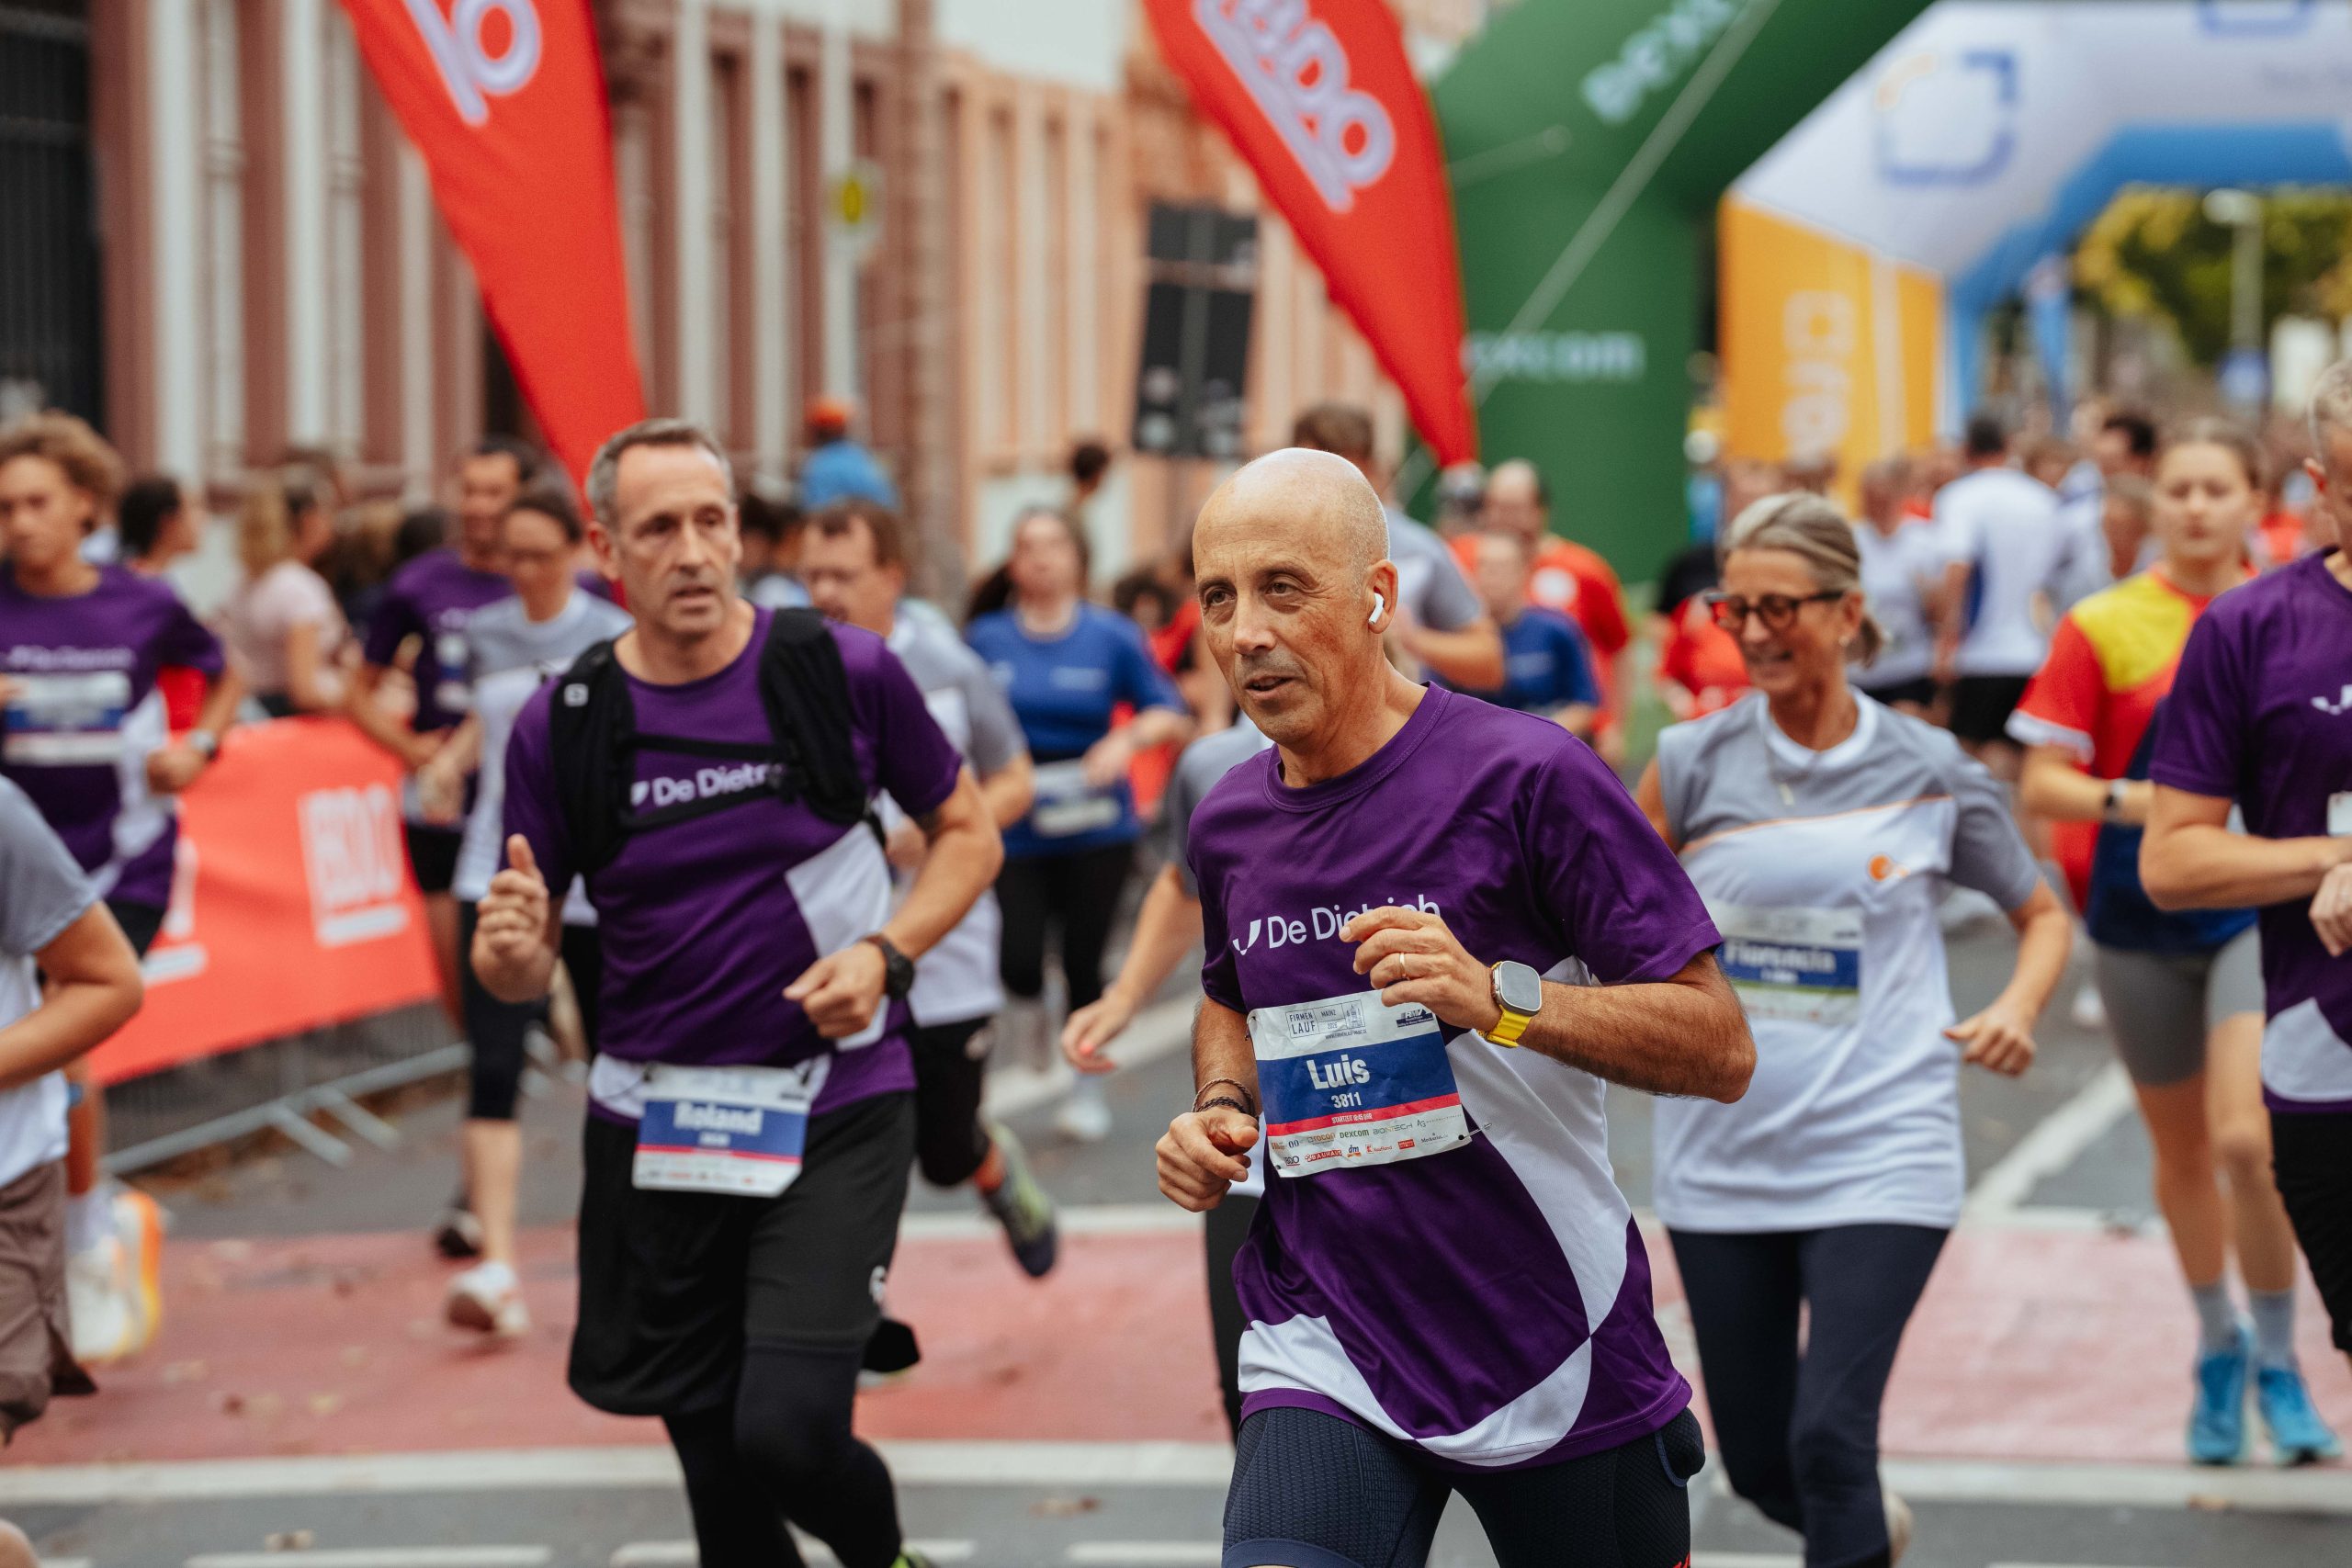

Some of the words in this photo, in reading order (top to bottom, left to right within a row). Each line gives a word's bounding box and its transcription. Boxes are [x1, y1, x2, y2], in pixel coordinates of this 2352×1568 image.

[652, 777, 695, 806] De
[696, 762, 772, 798] Dietr
[1268, 915, 1307, 949] De
[1289, 1011, 1314, 1022] FIRMEN
[1291, 1021, 1316, 1035] LAUF
[1306, 1054, 1370, 1089] Luis
[1330, 1091, 1362, 1109] 3811
[1373, 1122, 1413, 1135] BIONTECH
[1348, 1145, 1359, 1153] dm
